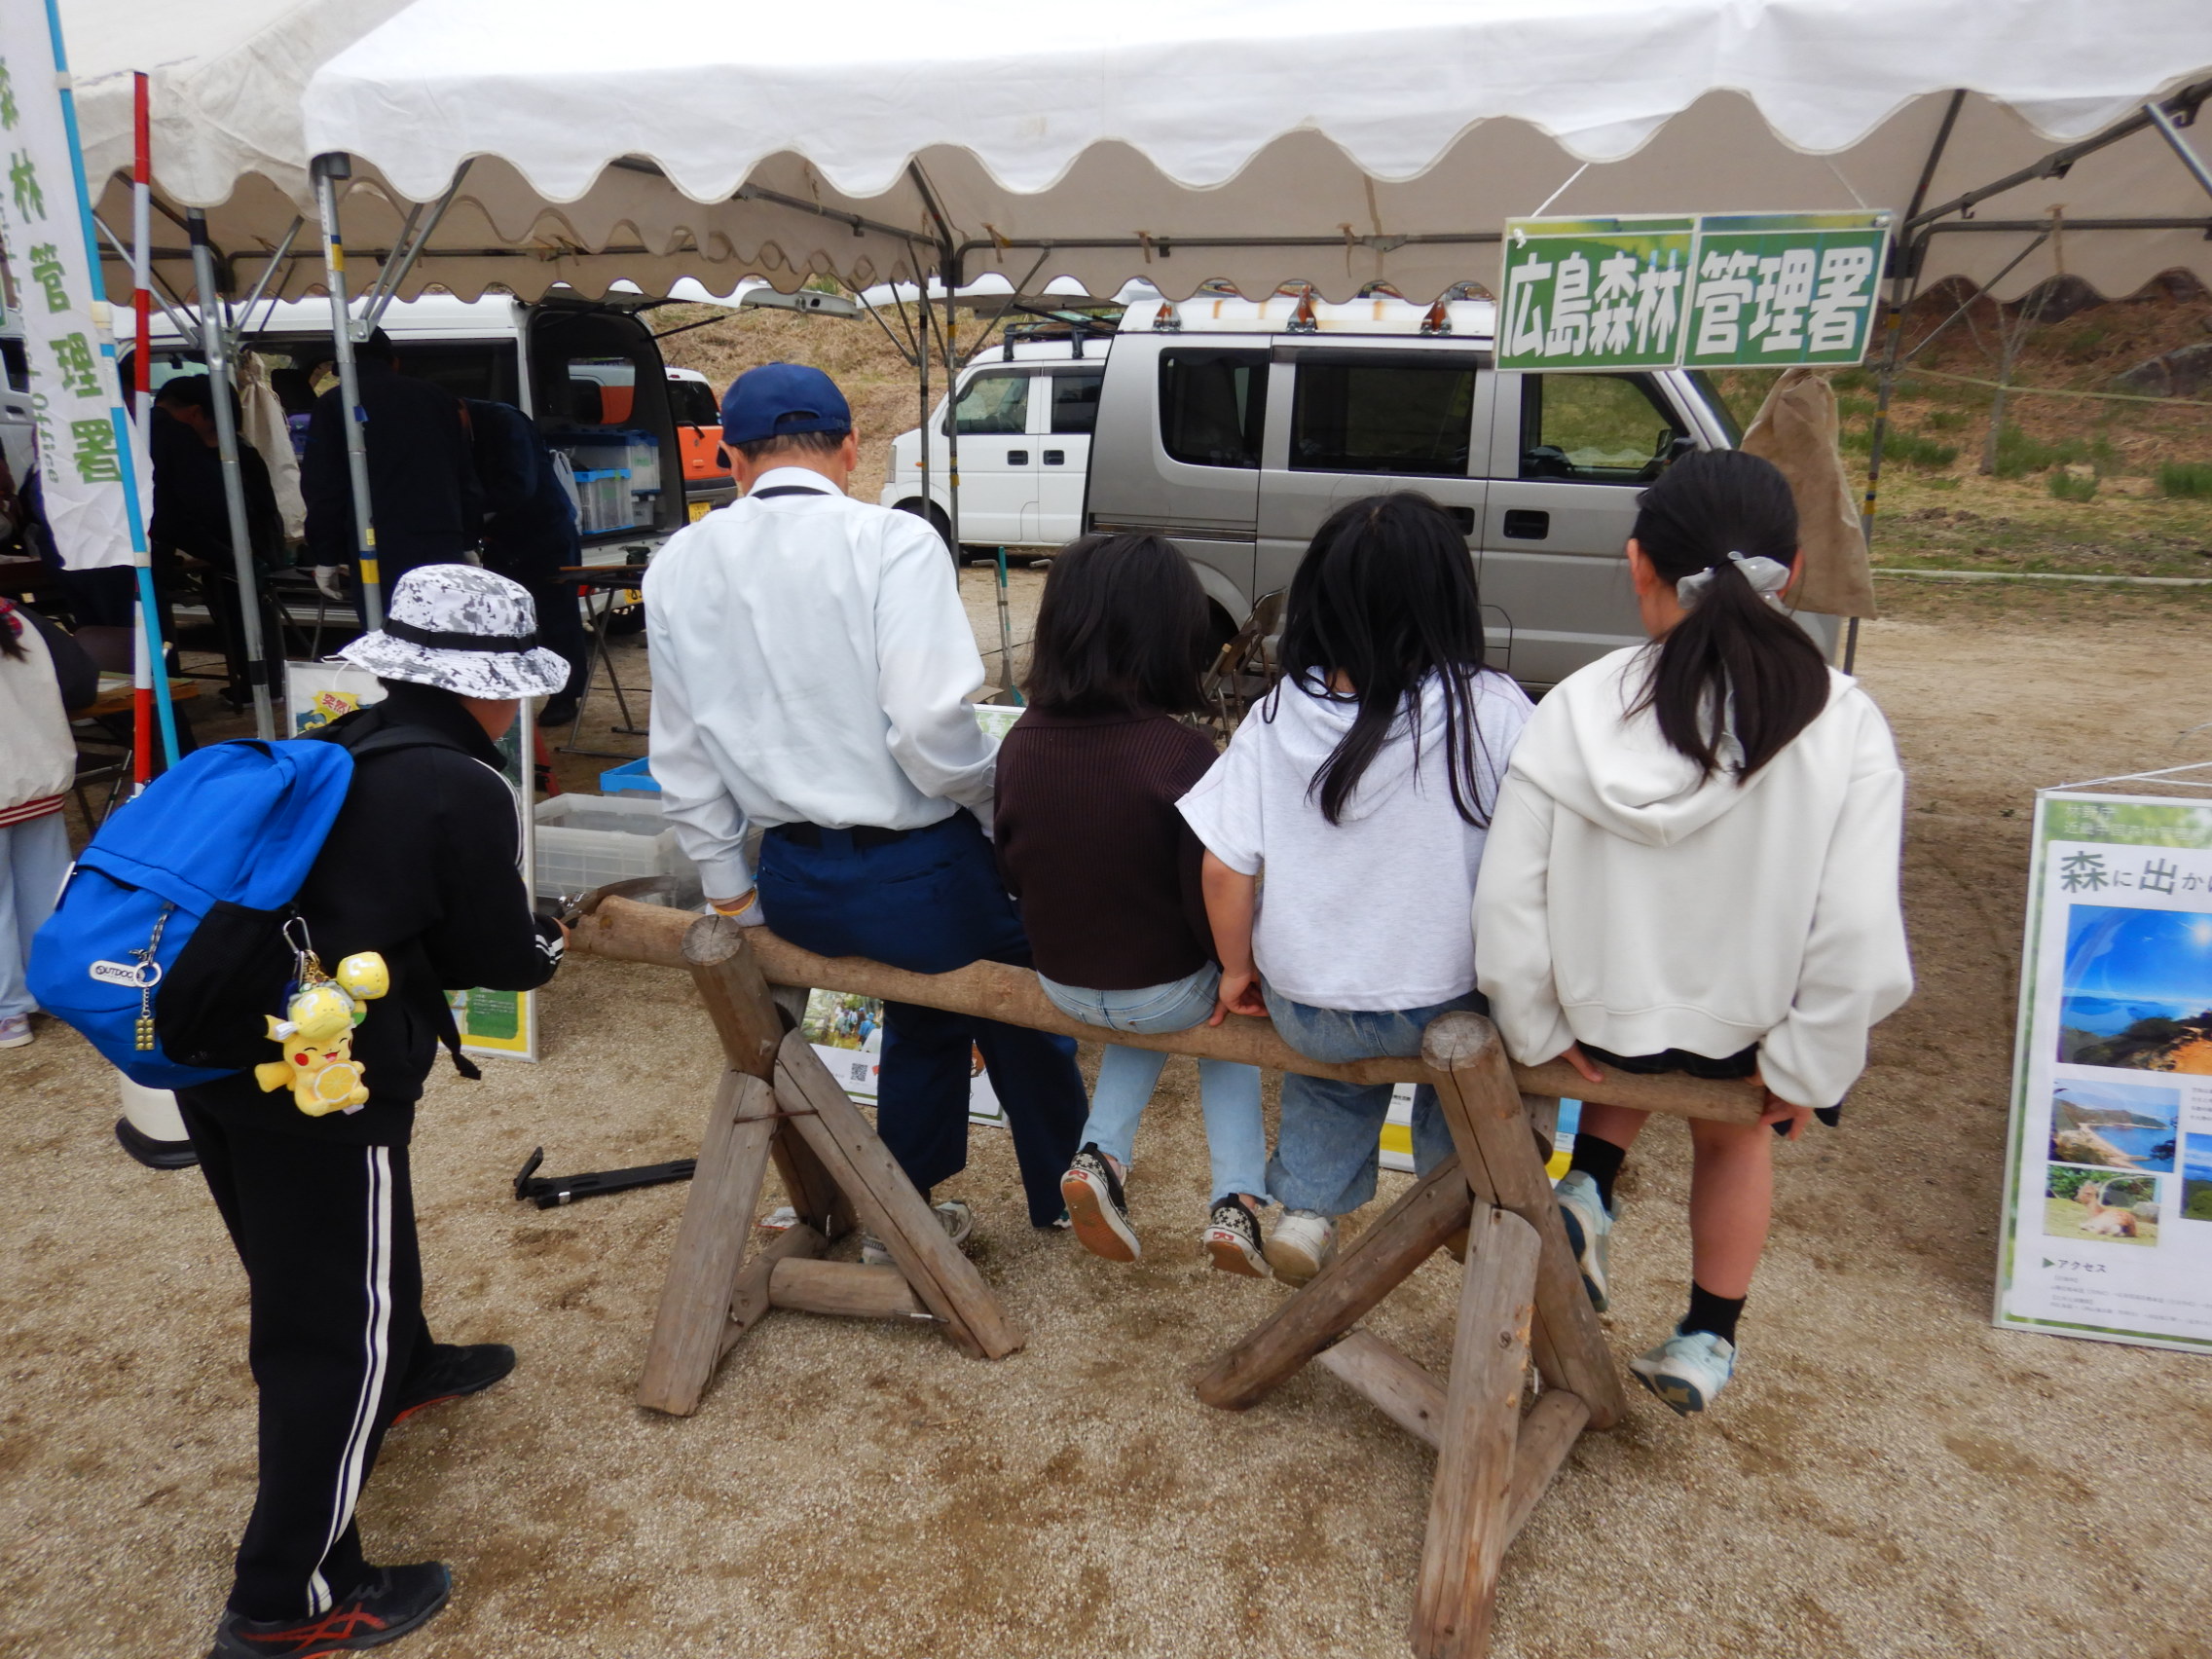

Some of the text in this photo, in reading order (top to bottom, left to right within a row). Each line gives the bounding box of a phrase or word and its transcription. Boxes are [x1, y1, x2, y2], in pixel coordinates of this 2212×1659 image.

[1501, 246, 1874, 358] 広島森林管理署
[31, 392, 59, 484] Office
[2060, 850, 2212, 896] 森に出か
[95, 965, 140, 979] OUTDOO
